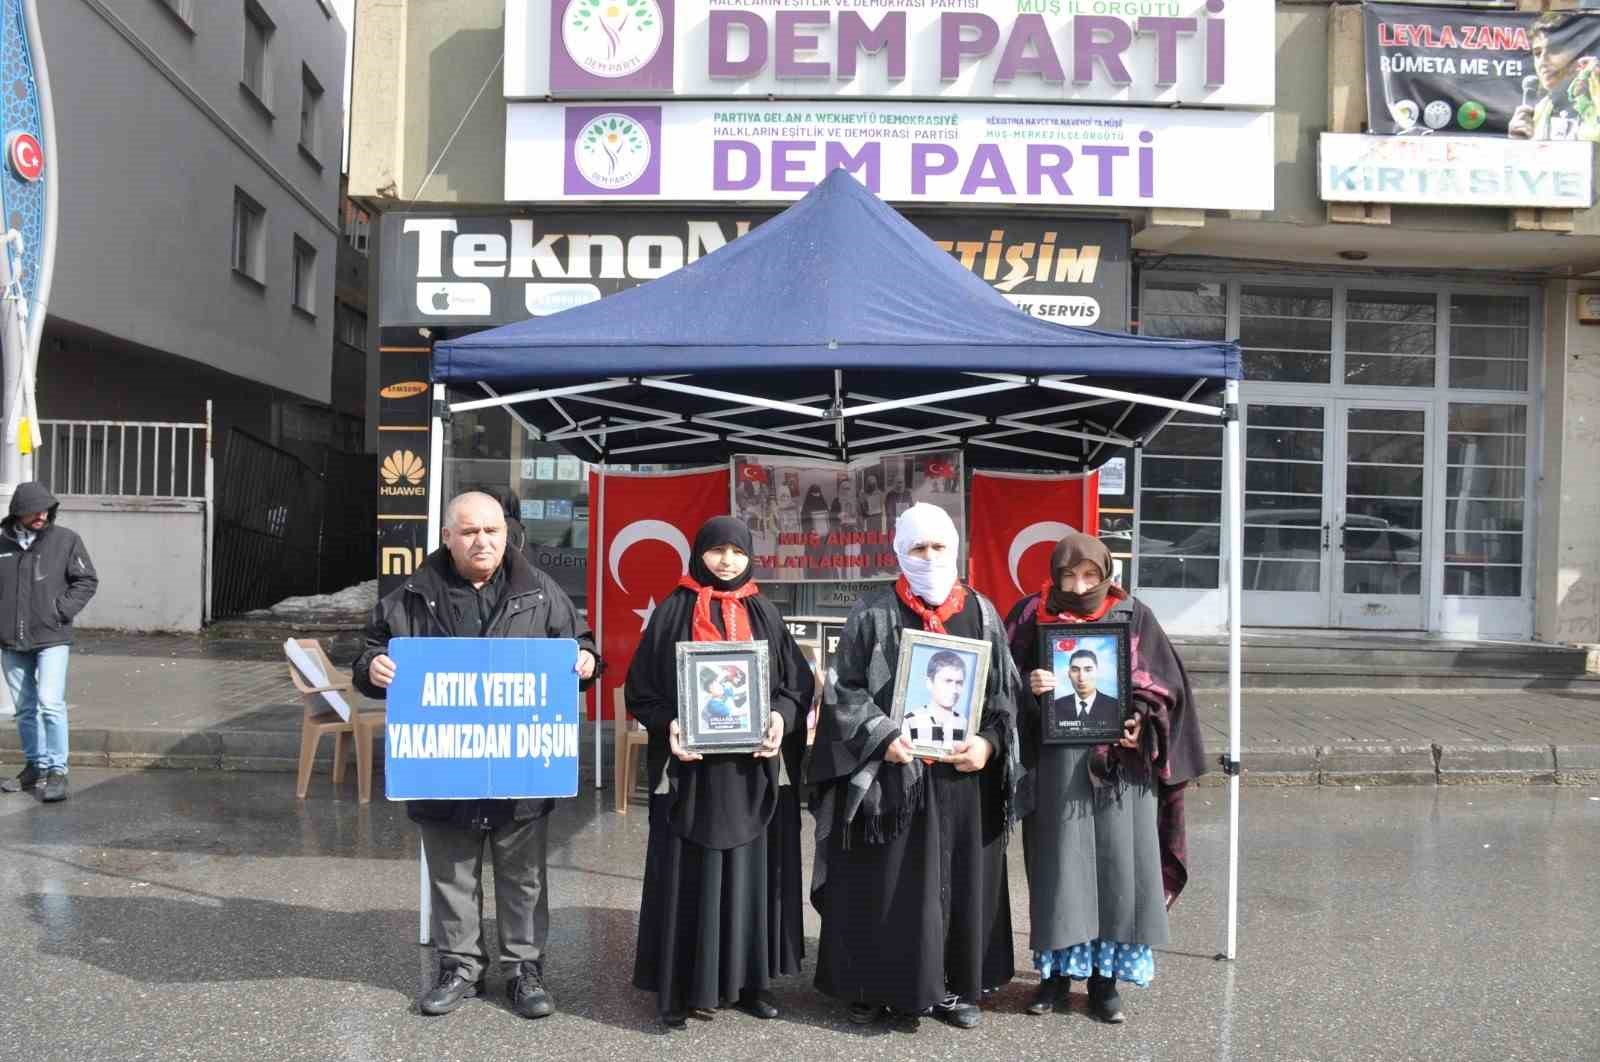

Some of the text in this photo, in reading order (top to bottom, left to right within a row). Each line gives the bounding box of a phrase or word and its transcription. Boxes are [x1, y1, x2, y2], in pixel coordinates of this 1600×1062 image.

[1017, 0, 1060, 16] MUŞ
[708, 0, 1225, 87] DEM PARTİ
[1378, 23, 1531, 50] LEYLA ZANA
[1460, 57, 1489, 76] ME
[1493, 60, 1523, 77] YE!
[713, 125, 959, 140] HALKLARIN EŞİTLİK VE DEMOKRASİ PARTİSİ
[713, 131, 1154, 198] DEM PARTİ
[1037, 302, 1095, 317] SERVİS
[380, 487, 426, 496] HUAWEI
[421, 672, 479, 707] ARTIK
[482, 672, 536, 707] YETER
[388, 714, 578, 768] YAKAMIZDAN DÜŞÜN
